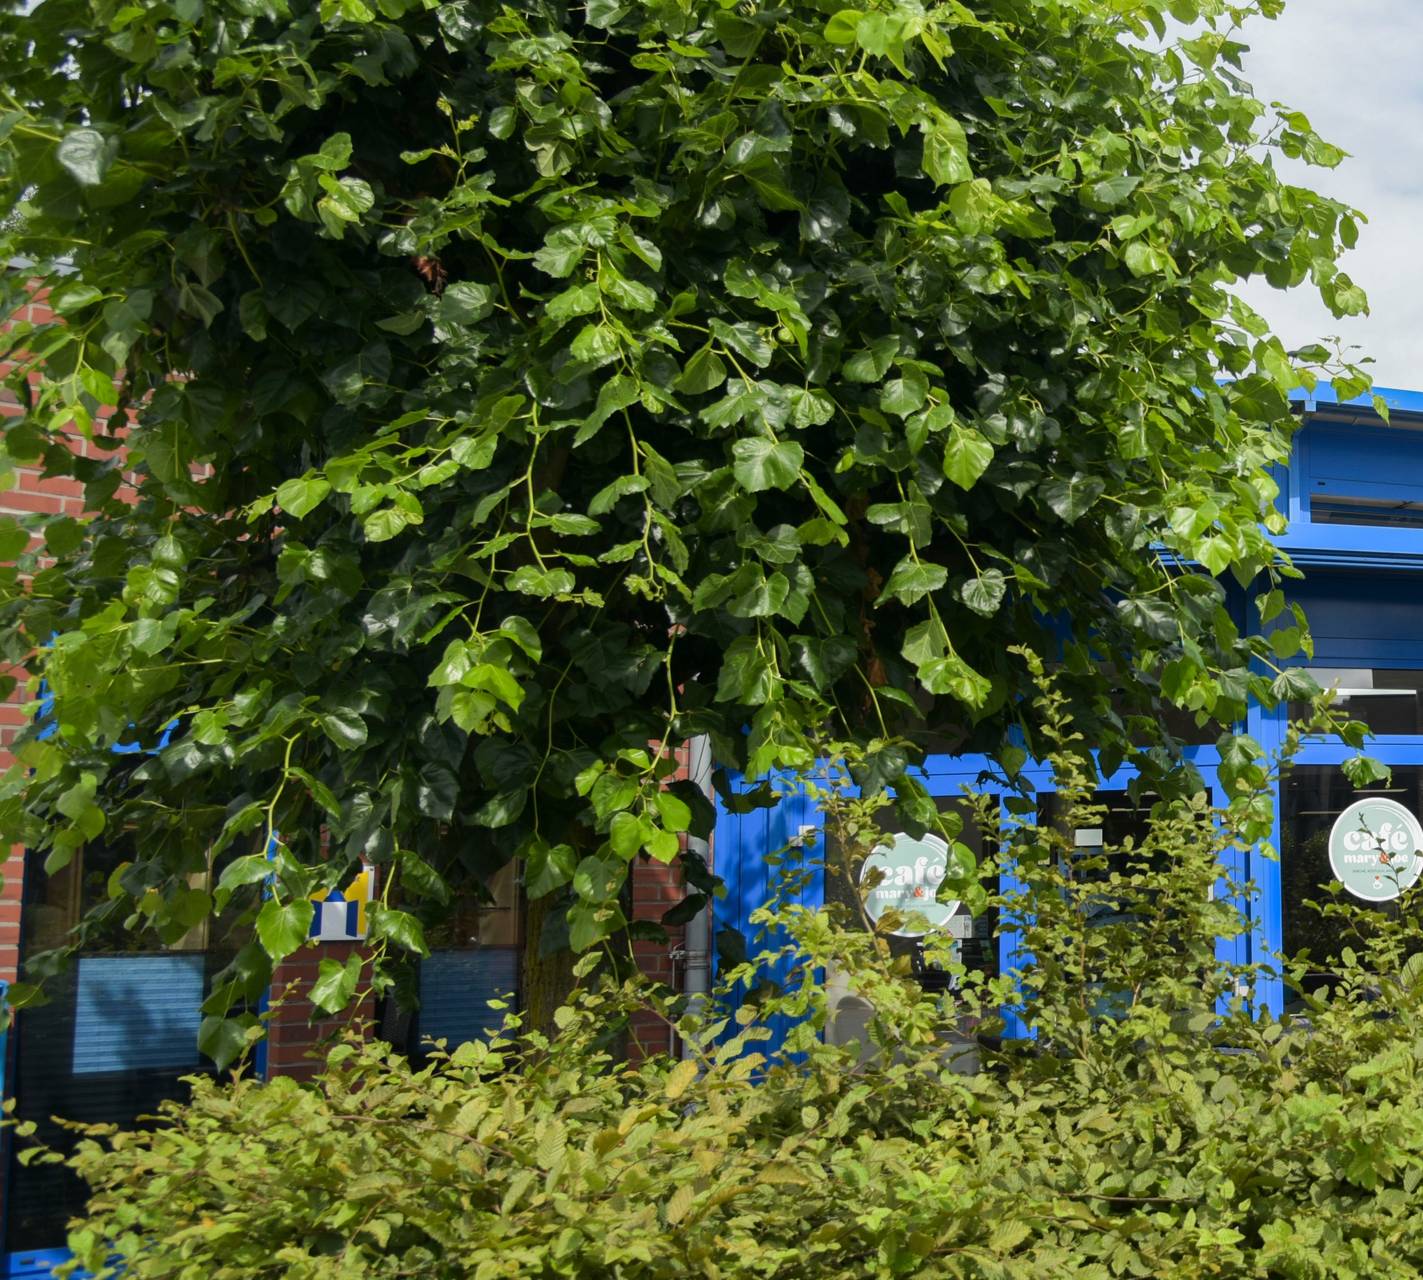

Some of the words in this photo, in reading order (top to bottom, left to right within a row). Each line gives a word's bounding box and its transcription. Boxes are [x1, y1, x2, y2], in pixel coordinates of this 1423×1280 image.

[1343, 822, 1409, 852] café
[877, 856, 946, 887] café
[1344, 853, 1409, 867] mary&oe
[875, 886, 937, 902] mary&jo
